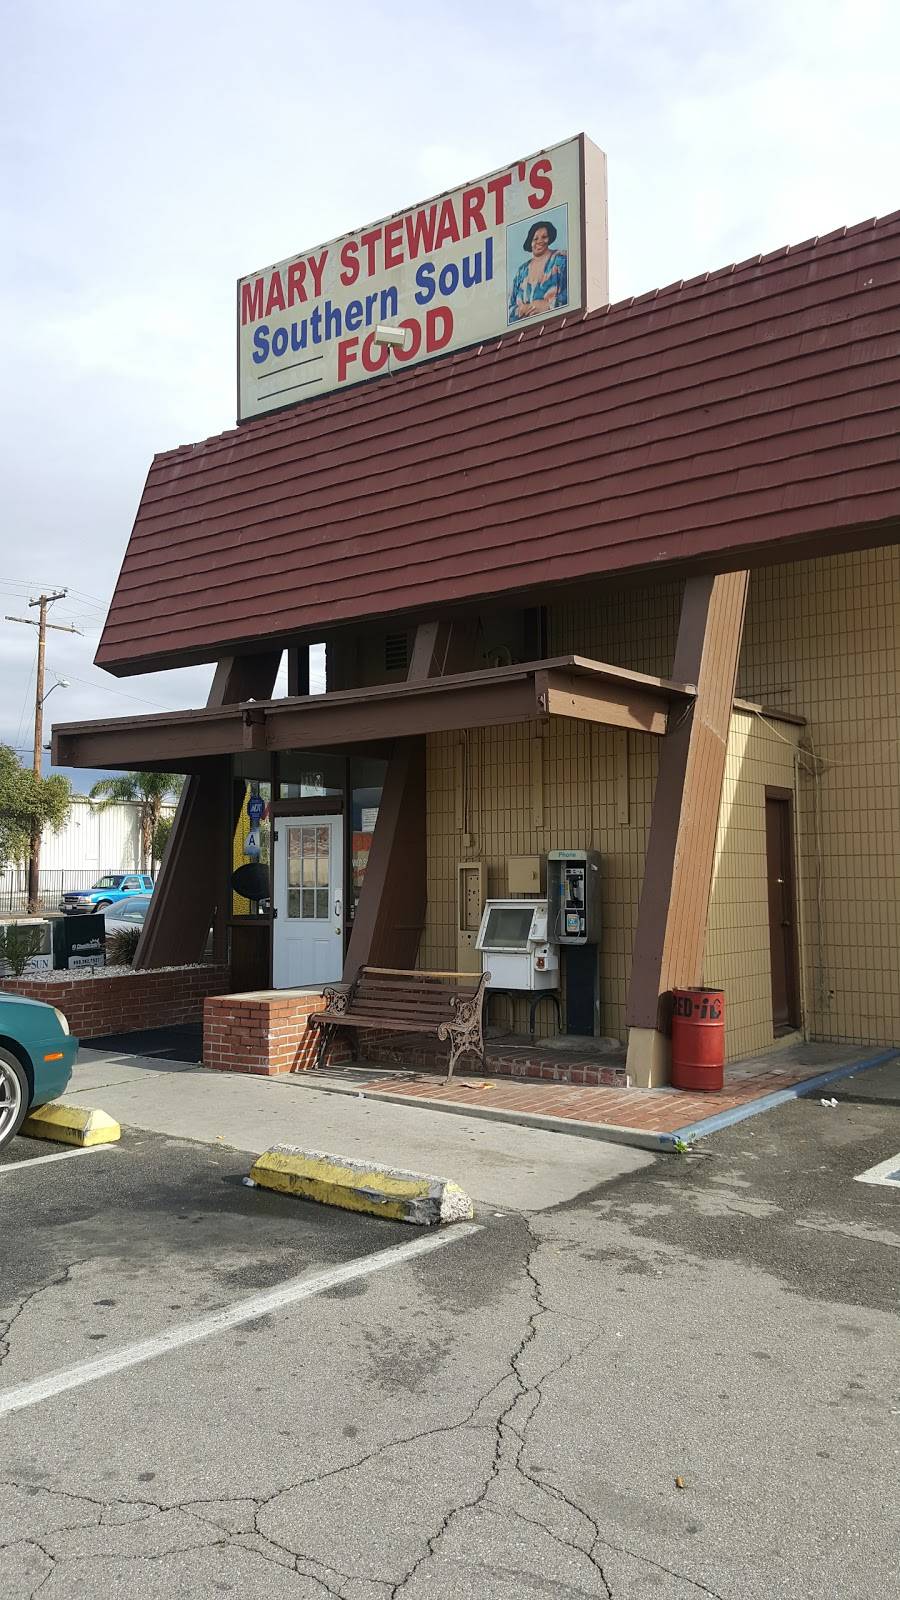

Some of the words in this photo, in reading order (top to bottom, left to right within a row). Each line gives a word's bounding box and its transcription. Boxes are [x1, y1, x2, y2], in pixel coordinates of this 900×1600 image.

[241, 250, 329, 326] MARY
[339, 158, 553, 287] STEWART'S
[252, 285, 398, 365] Southern
[414, 237, 494, 305] Soul
[337, 305, 454, 382] FOOD
[249, 834, 256, 846] A
[31, 959, 49, 970] SUN
